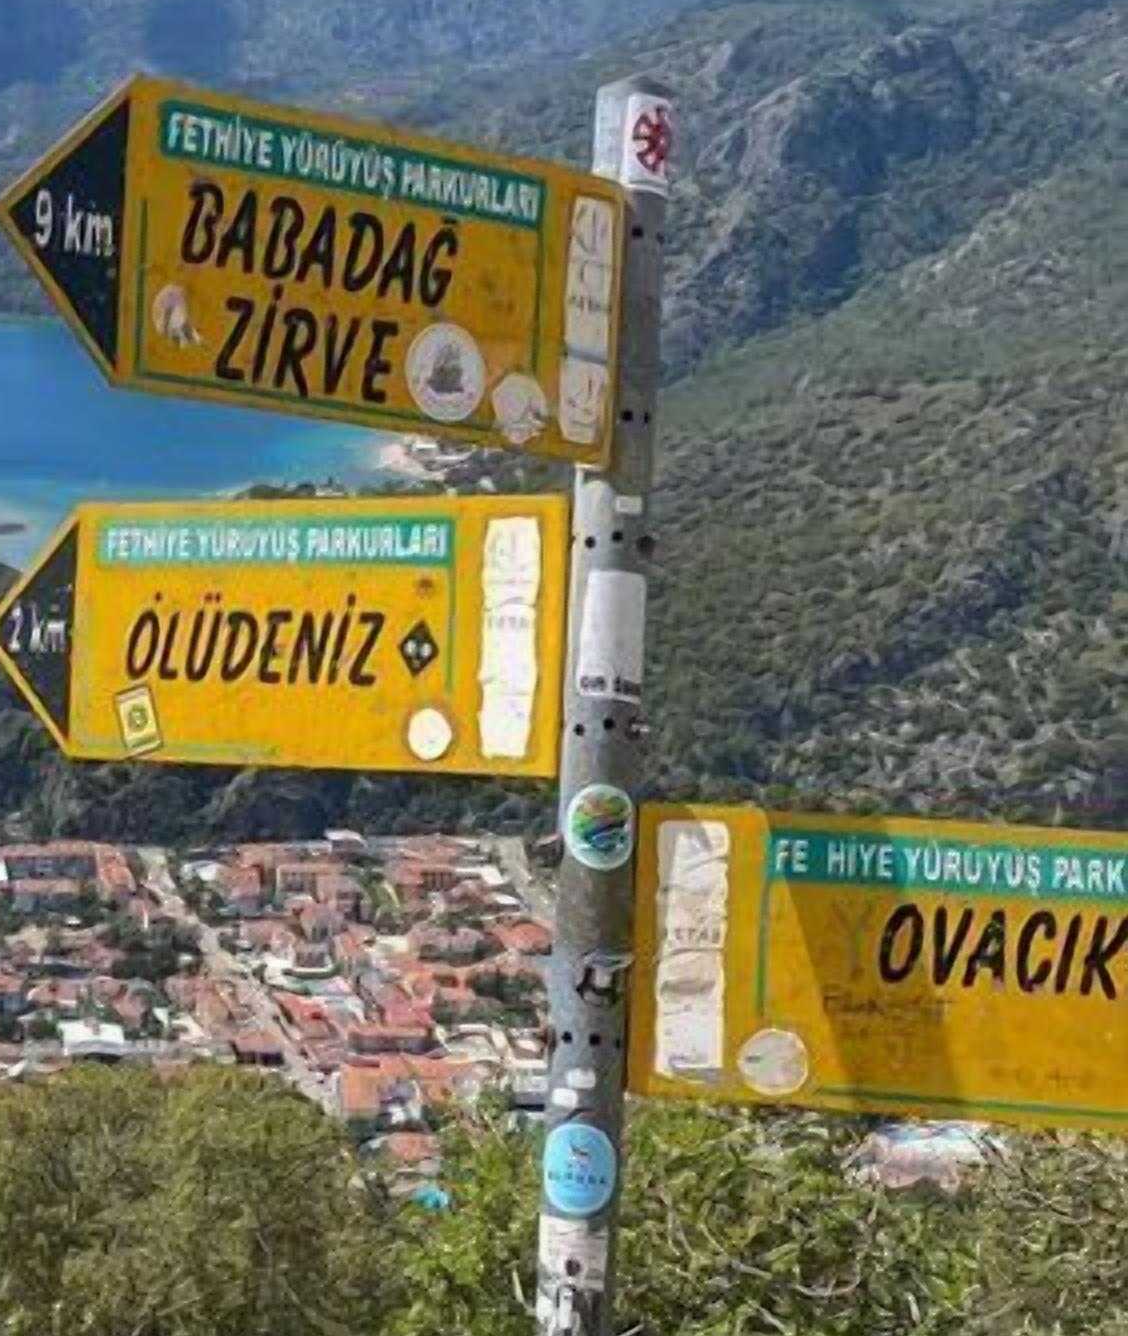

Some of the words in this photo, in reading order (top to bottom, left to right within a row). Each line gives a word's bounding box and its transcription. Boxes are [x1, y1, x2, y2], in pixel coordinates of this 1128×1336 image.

[34, 189, 53, 246] 9
[63, 194, 114, 256] km
[401, 161, 539, 221] PARKURLARI
[180, 182, 458, 306] BABADAĞ
[215, 285, 398, 403] ZİRVE
[306, 523, 447, 559] PARKURLARI
[8, 601, 23, 652] 2
[29, 601, 66, 653] km
[775, 836, 893, 878] FEHİYE
[1052, 855, 1126, 894] PARK
[880, 903, 1128, 1000] OVACIK
